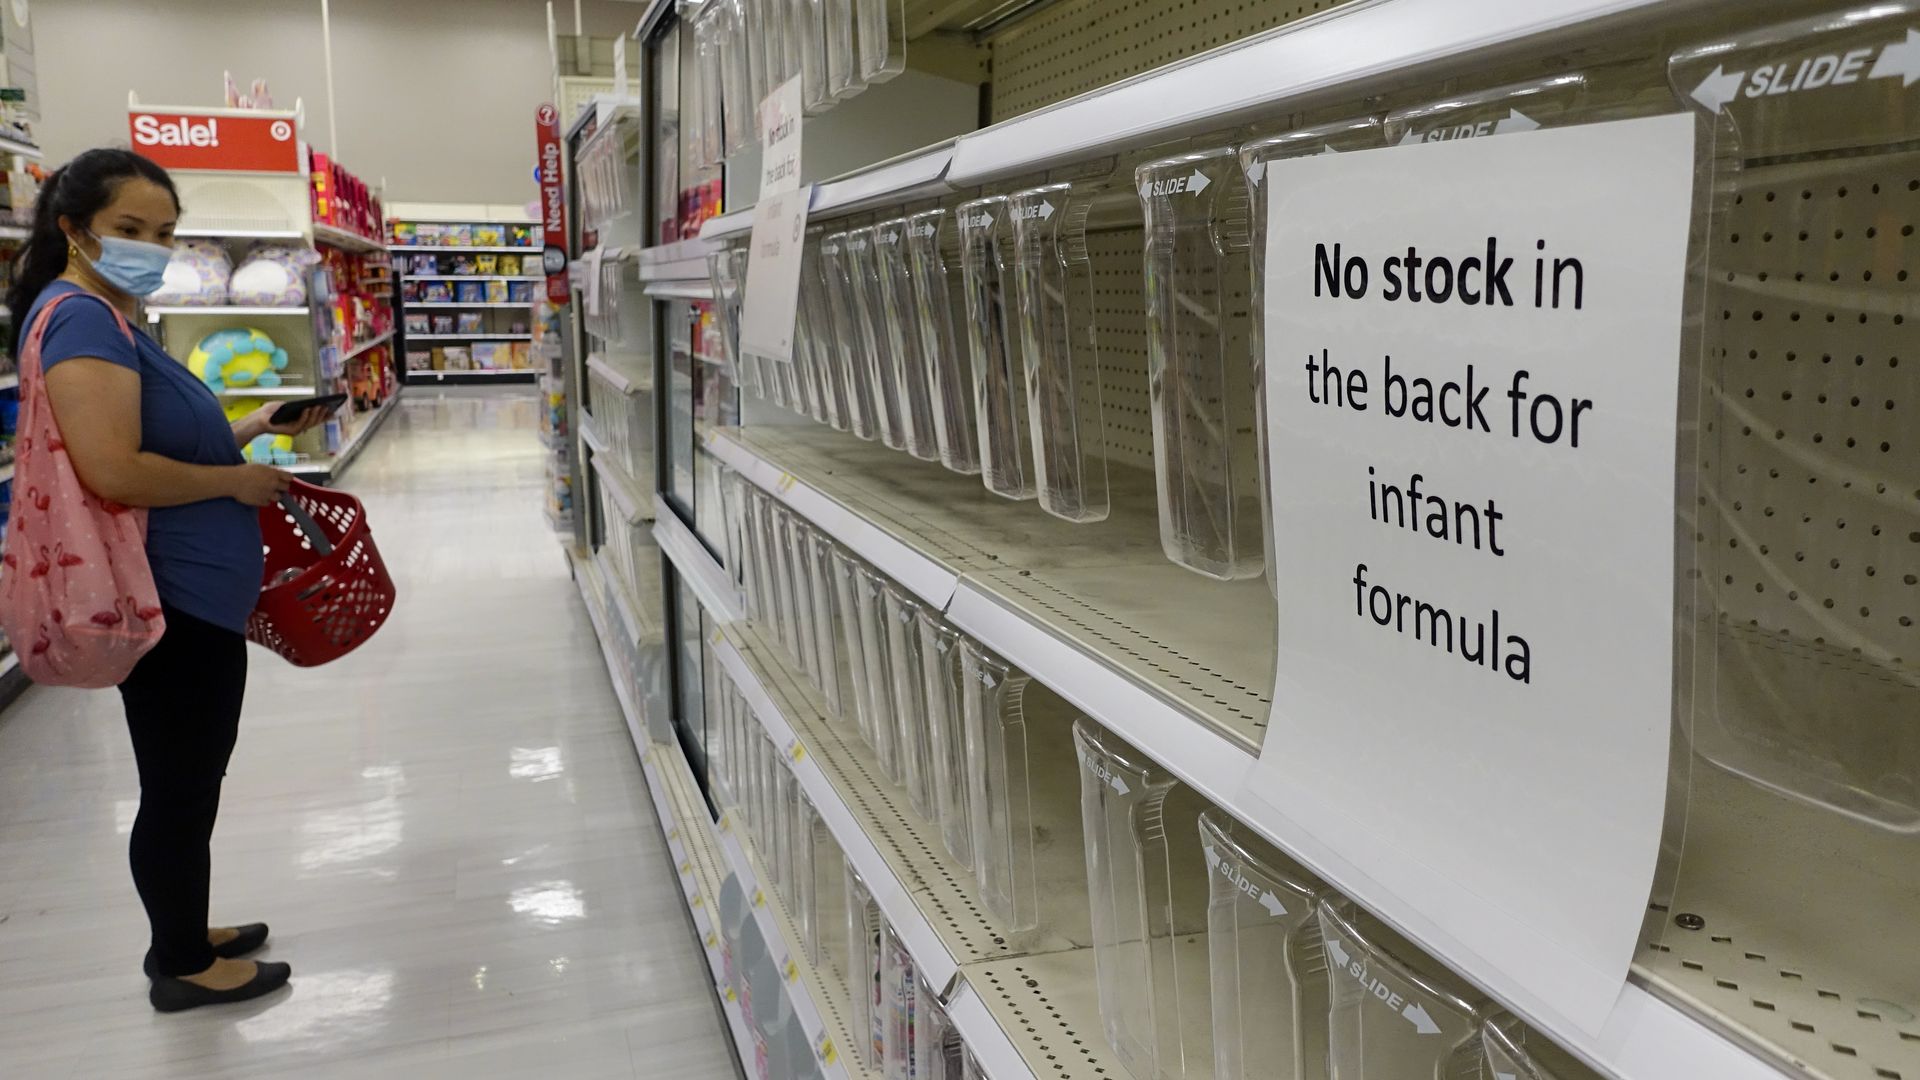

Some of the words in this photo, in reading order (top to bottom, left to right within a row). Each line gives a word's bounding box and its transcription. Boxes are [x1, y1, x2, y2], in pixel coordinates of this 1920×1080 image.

[1744, 48, 1873, 99] SLIDE
[134, 105, 220, 147] Sale!
[543, 142, 560, 183] Help
[1152, 176, 1187, 196] SLIDE
[544, 186, 562, 232] Need
[1314, 243, 1368, 299] No
[1383, 237, 1513, 306] stock
[1535, 239, 1583, 310] in
[1306, 349, 1367, 411] the
[1385, 355, 1490, 432] back
[1507, 370, 1593, 448] for
[1368, 466, 1504, 556] infant
[1353, 563, 1530, 685] formula
[1086, 757, 1112, 783] SLIDE
[1221, 862, 1260, 900] SLIDE
[1350, 962, 1404, 1011] SLIDE
